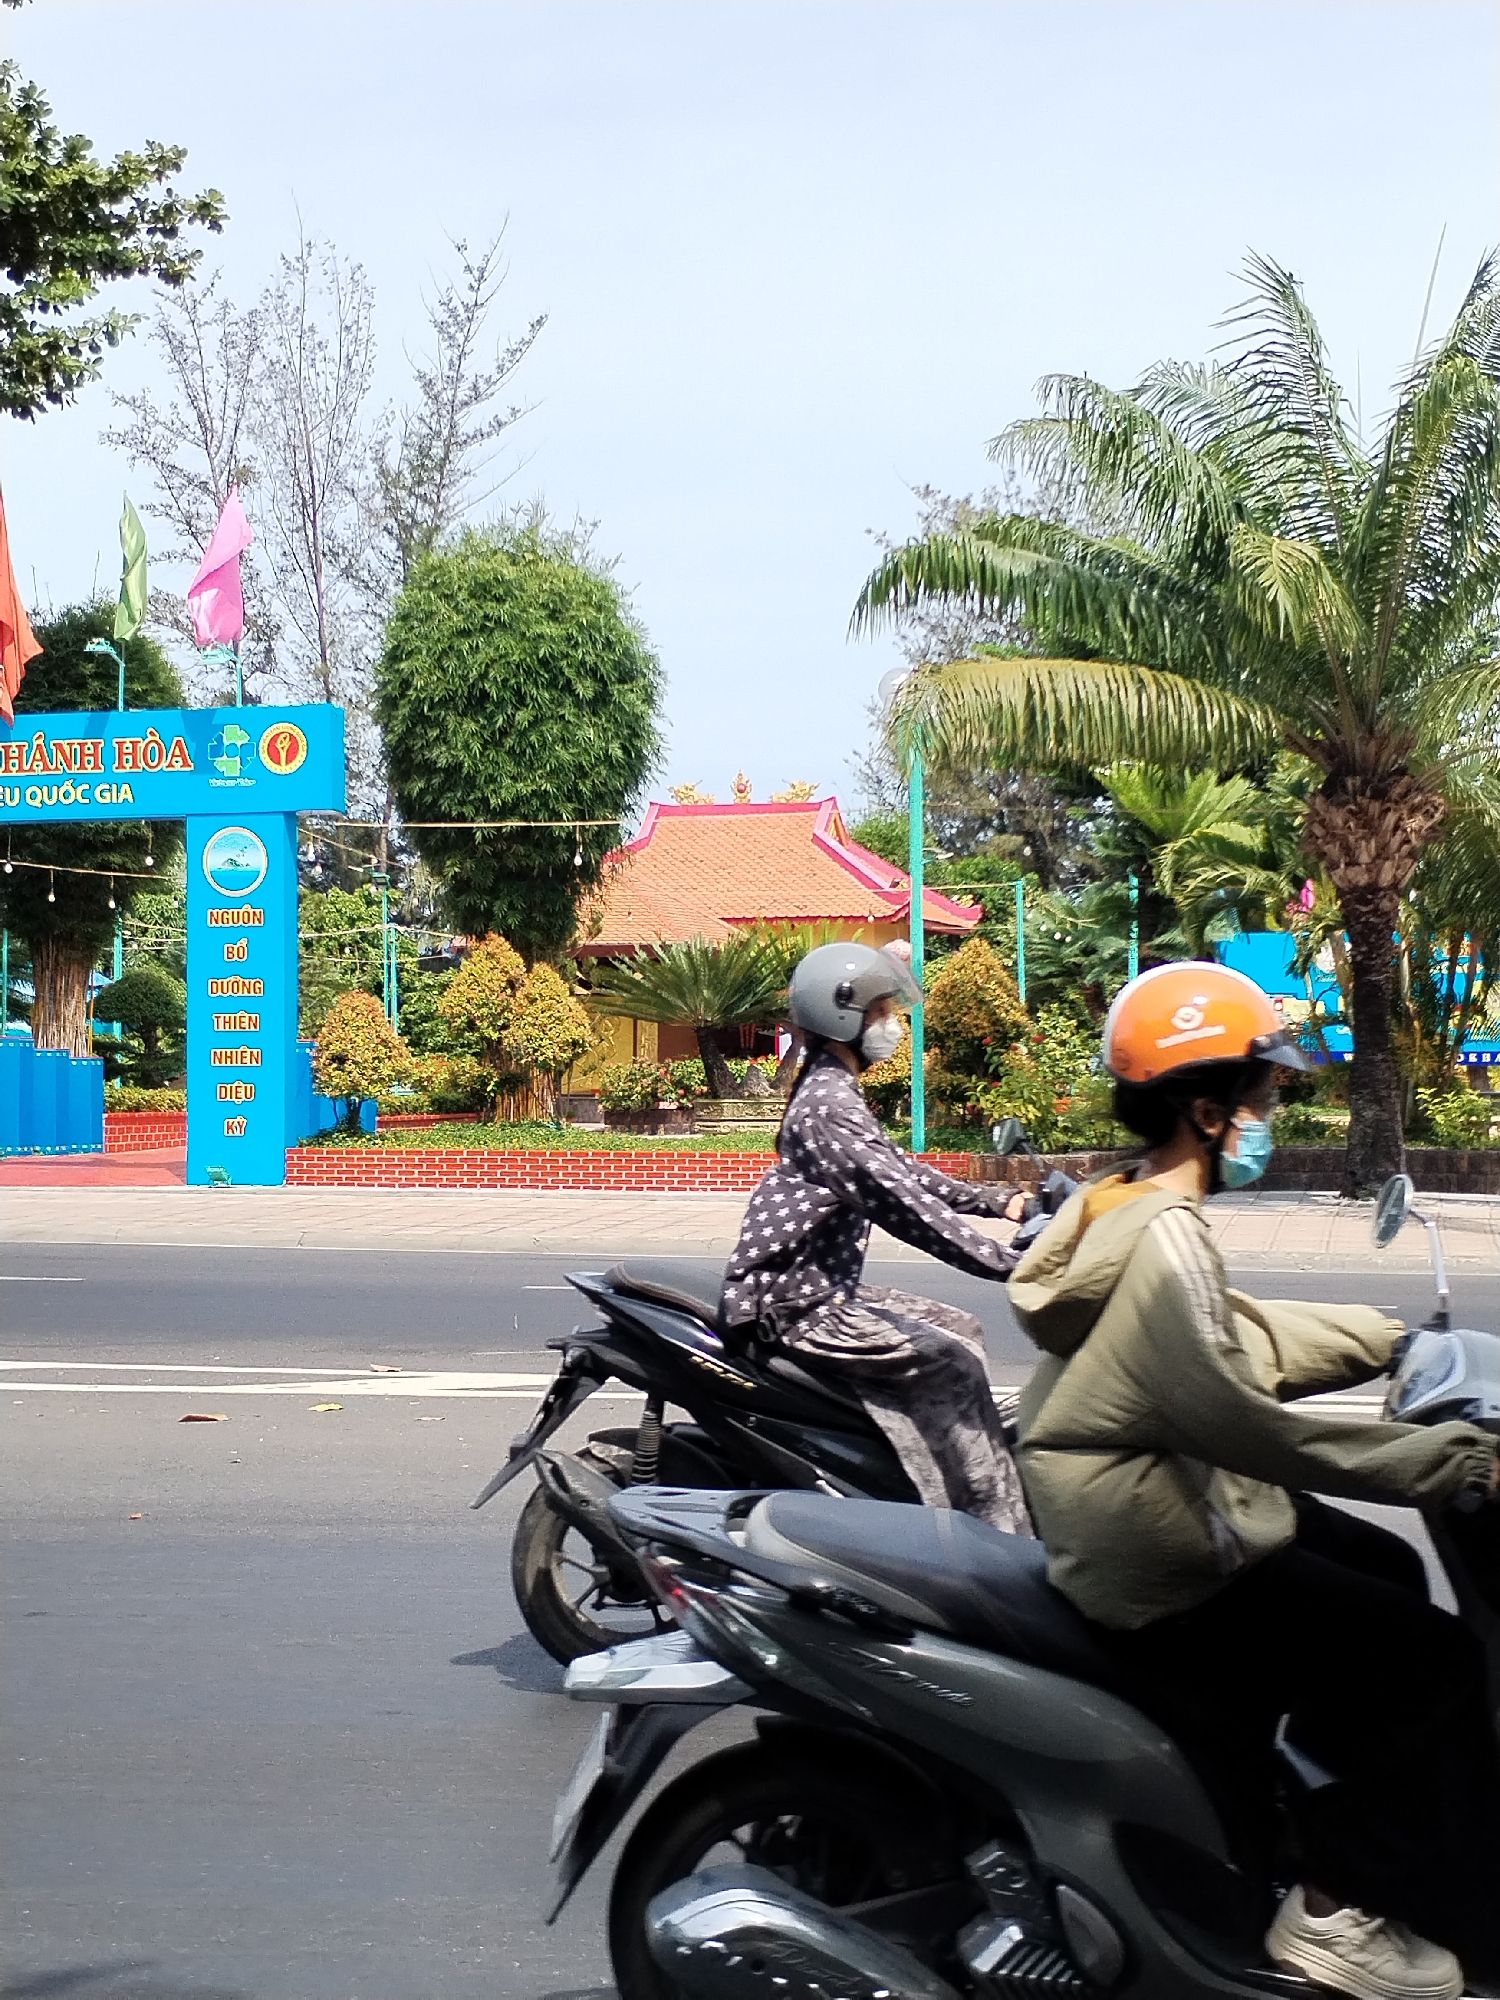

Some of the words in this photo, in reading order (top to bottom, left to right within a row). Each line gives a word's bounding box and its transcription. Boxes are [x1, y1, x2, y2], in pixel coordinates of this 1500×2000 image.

[0, 732, 104, 775] HÁNH
[113, 727, 194, 772] HÒA
[25, 779, 91, 808] QUỐC
[94, 783, 134, 803] GIA
[208, 904, 263, 926] NGUỒN
[208, 976, 263, 996] DƯỠNG
[213, 1011, 259, 1031] THIÊN
[211, 1046, 261, 1065] NHIÊN
[218, 1081, 254, 1103] DIỆU
